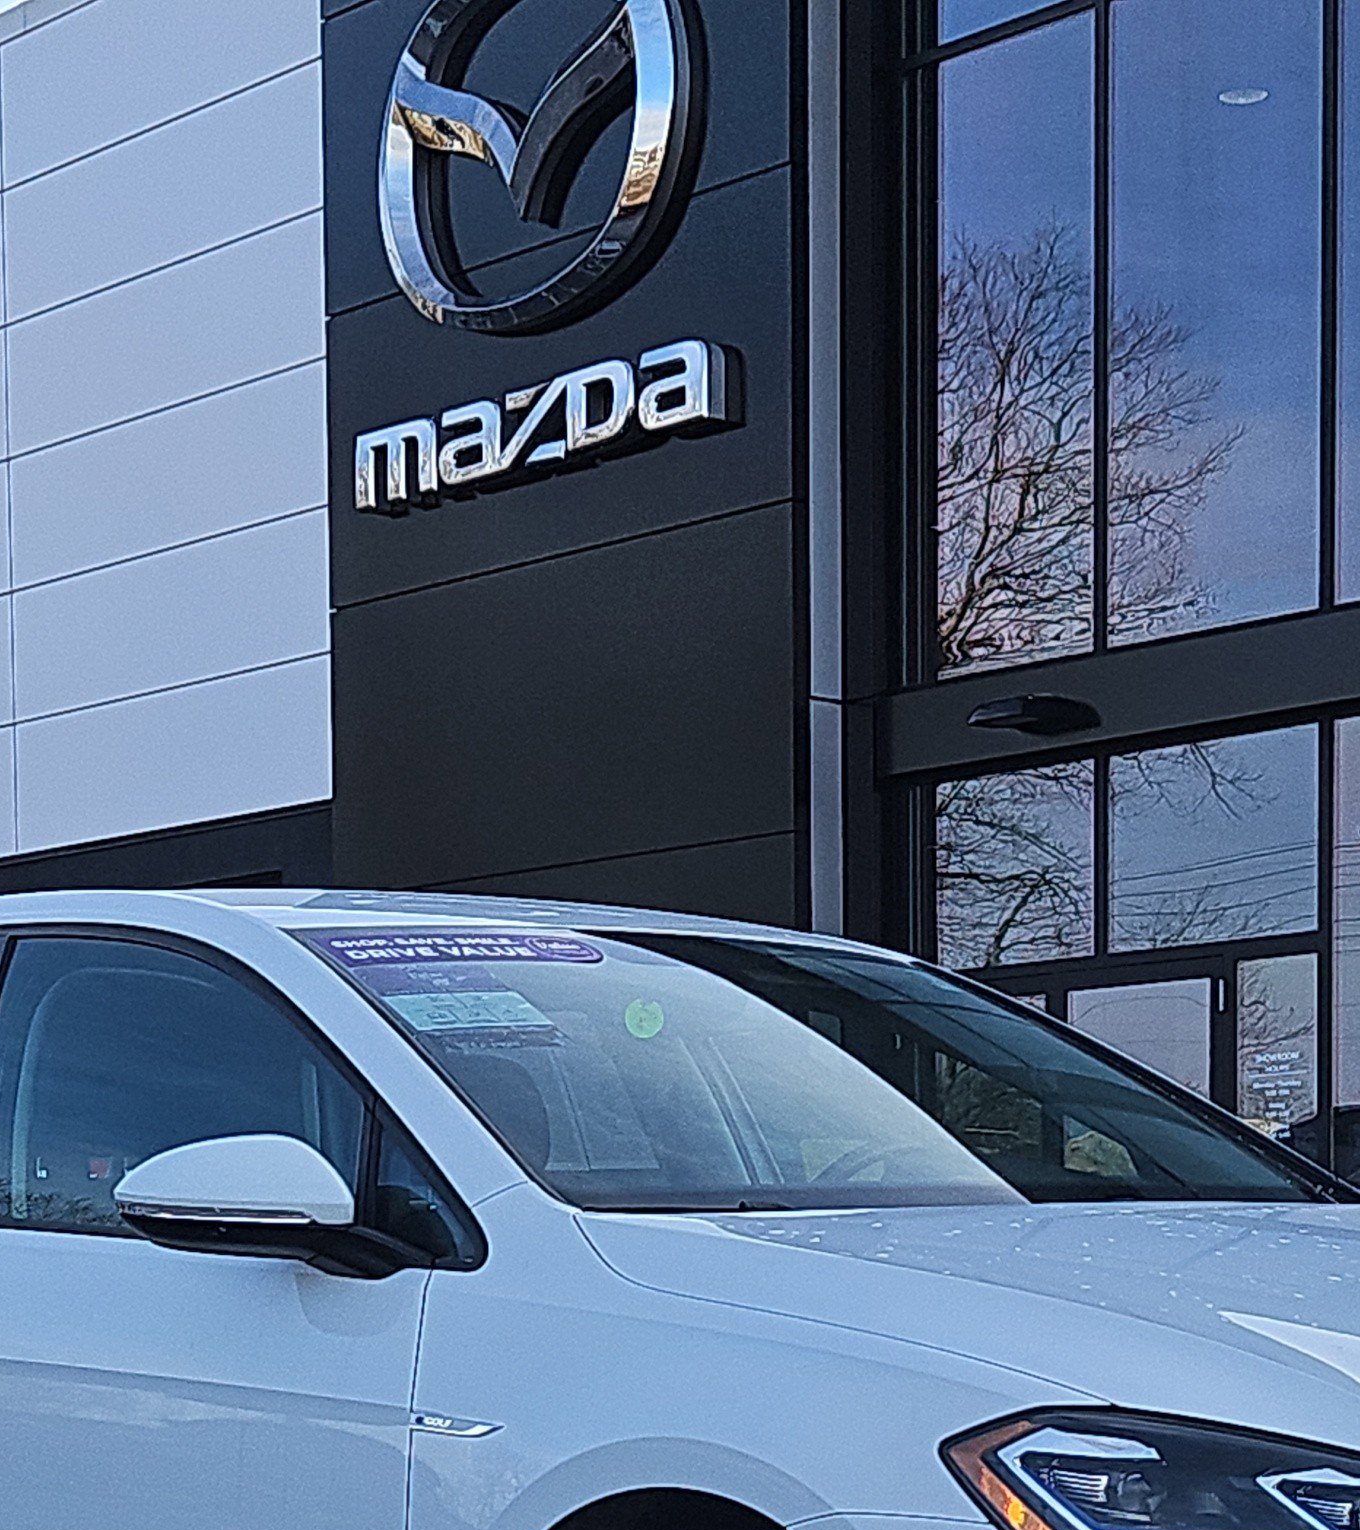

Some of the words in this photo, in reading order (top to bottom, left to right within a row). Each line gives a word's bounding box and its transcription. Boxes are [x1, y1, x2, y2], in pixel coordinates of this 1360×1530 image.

[355, 337, 718, 510] mazda
[344, 946, 440, 960] DRIVE
[440, 945, 537, 958] VALUE
